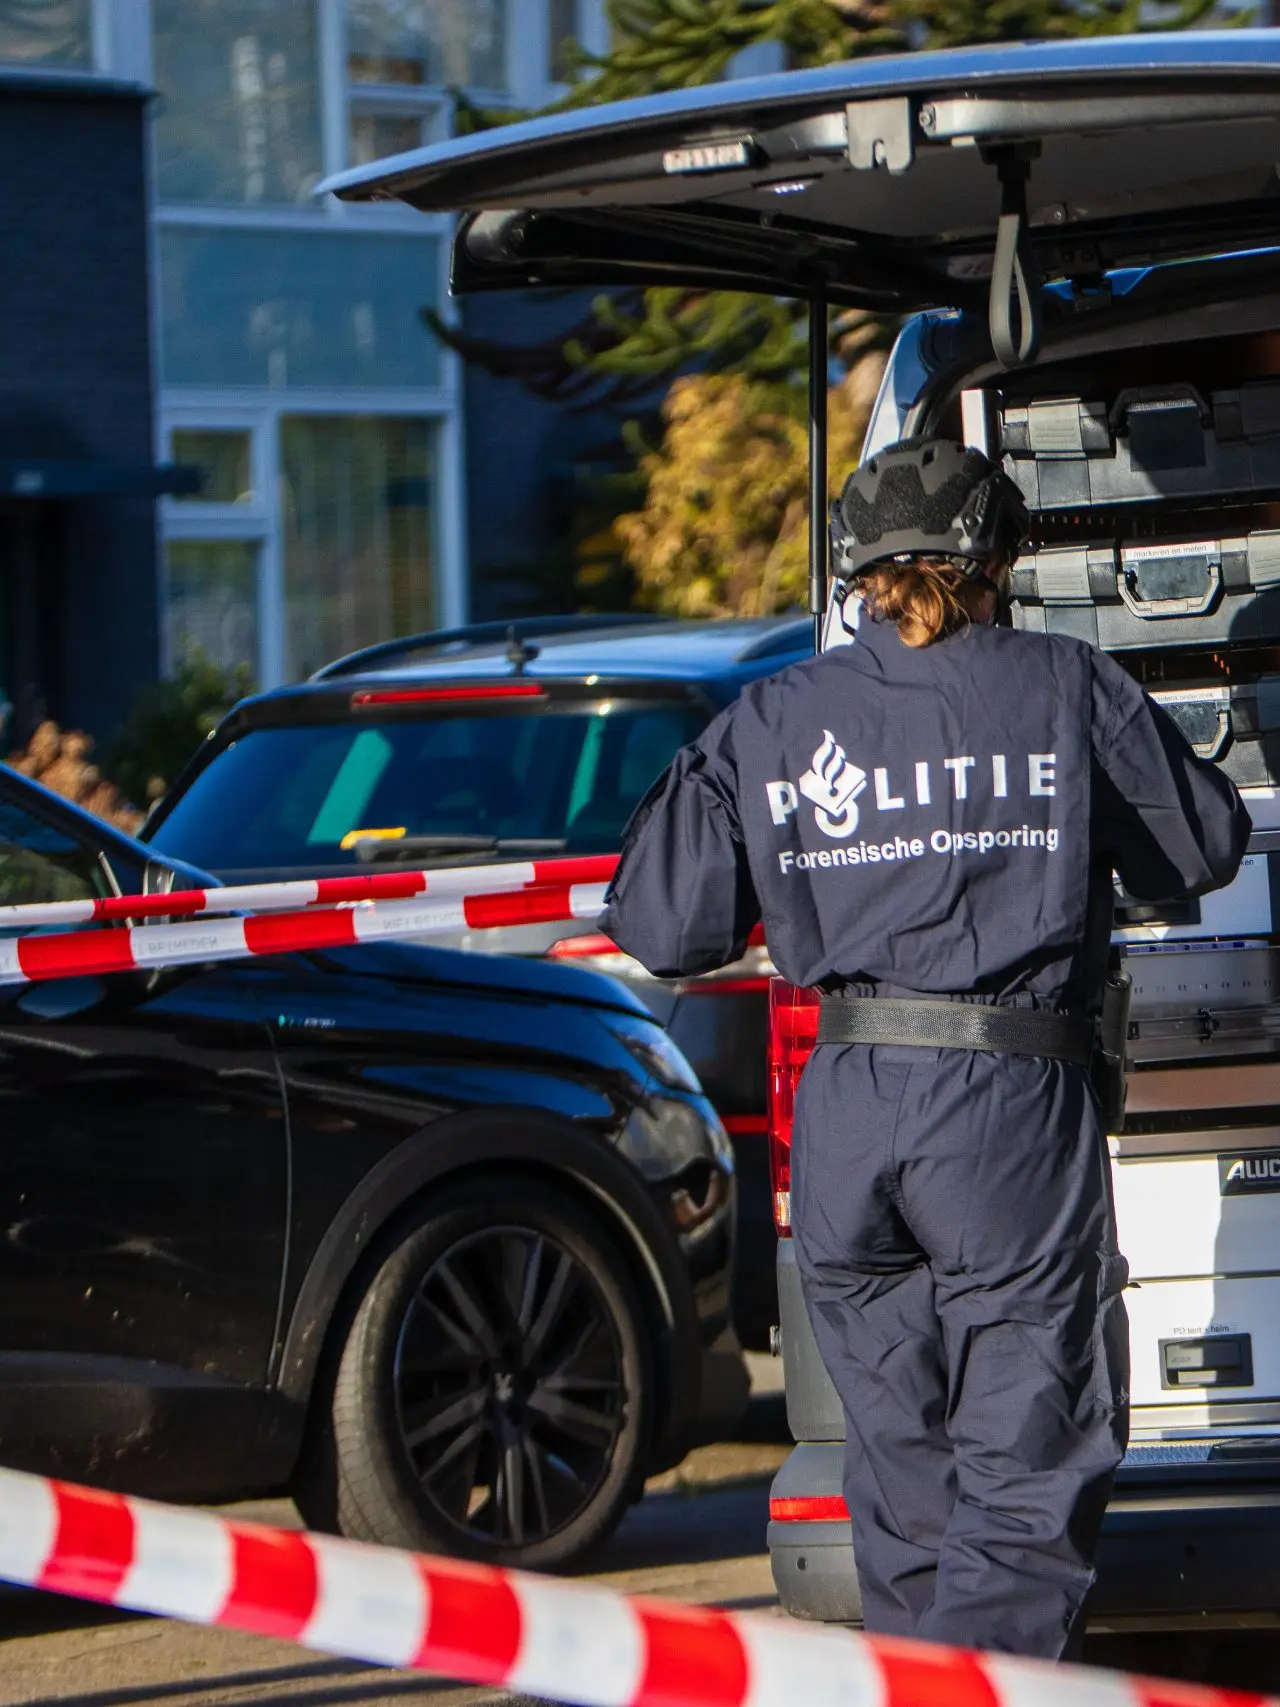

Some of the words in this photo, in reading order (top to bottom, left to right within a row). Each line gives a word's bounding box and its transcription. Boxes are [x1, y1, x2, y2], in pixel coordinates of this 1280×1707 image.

[766, 745, 1057, 838] POLITIE
[778, 836, 925, 874] Forensische
[930, 825, 1059, 855] Opsporing
[1210, 1325, 1230, 1333] helm
